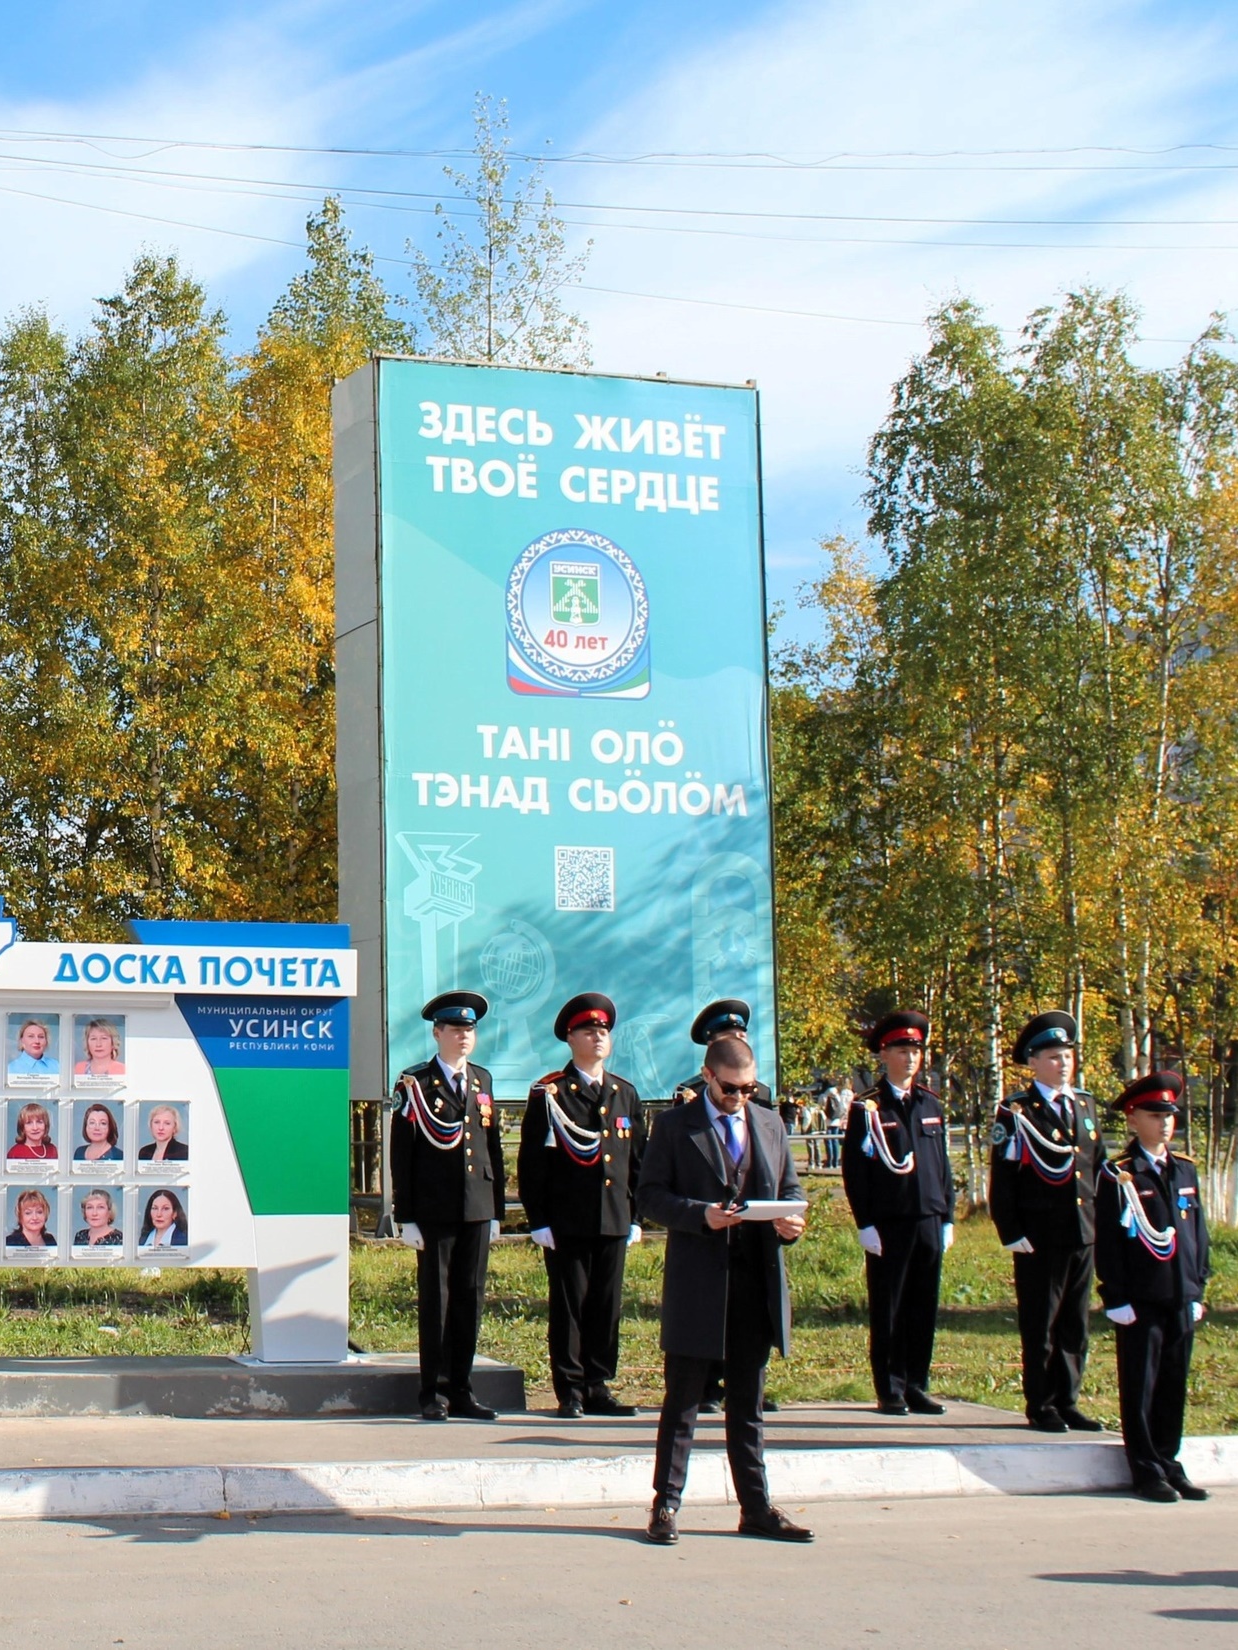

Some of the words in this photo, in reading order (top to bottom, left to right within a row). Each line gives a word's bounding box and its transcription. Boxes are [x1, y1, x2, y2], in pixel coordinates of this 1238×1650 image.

[418, 402, 552, 447] ЗДЕСЬ
[574, 413, 726, 460] ЖИВЁТ
[426, 453, 538, 499] ТВОЁ
[559, 466, 719, 515] СЕРДЦЕ
[553, 564, 597, 576] УСИНСК
[544, 629, 568, 648] 40
[574, 635, 609, 651] лет
[477, 725, 570, 762] ТАНІ
[590, 720, 684, 767] ОЛӦ
[412, 772, 550, 815] ТЭНАД
[568, 768, 748, 817] СЬӦЛӦМ
[53, 952, 186, 985] ДОСКА
[198, 956, 341, 988] ПОЧЕТА
[197, 1006, 297, 1016] МУНИЦИПАЛЬНЫЙ
[301, 1008, 334, 1016] ОКРУГ
[229, 1019, 334, 1039] УСИНСК
[229, 1041, 299, 1051] РЕСПУБЛИКИ
[303, 1043, 335, 1052] КОМИ
